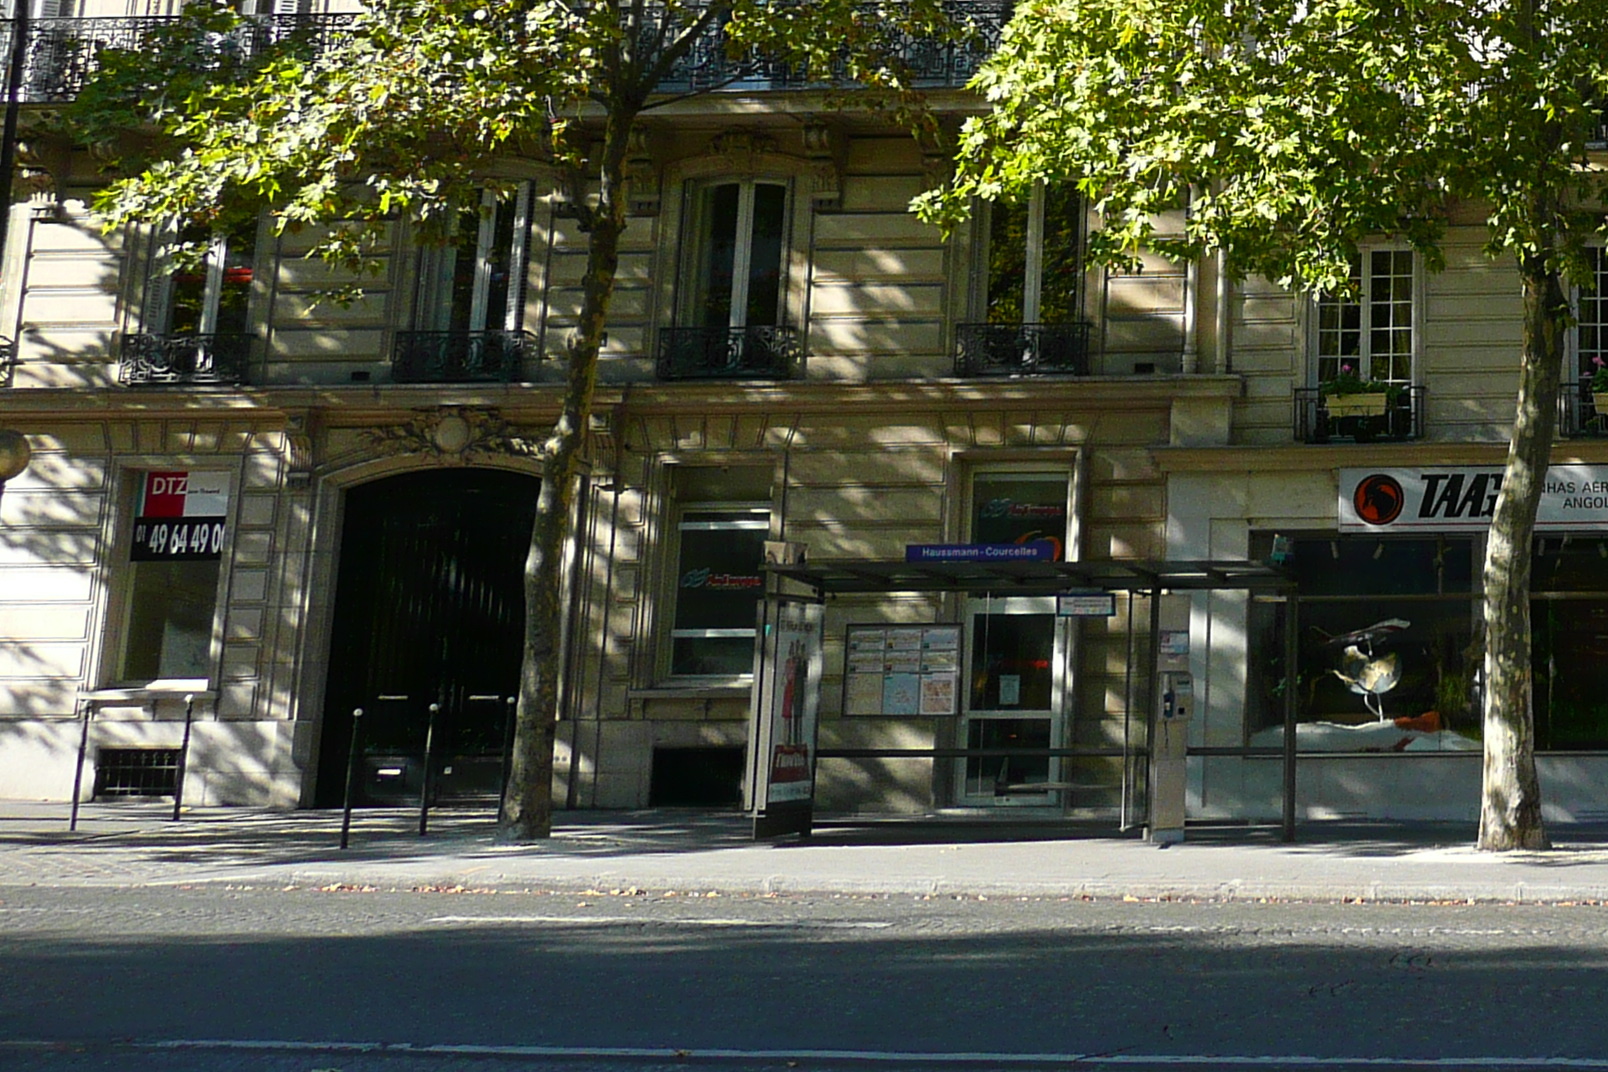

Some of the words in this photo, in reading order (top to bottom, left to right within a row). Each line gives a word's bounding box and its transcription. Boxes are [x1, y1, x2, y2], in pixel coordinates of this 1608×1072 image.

[152, 477, 188, 495] DTZ
[149, 524, 168, 553] 49
[170, 524, 188, 554] 64
[190, 524, 209, 553] 49
